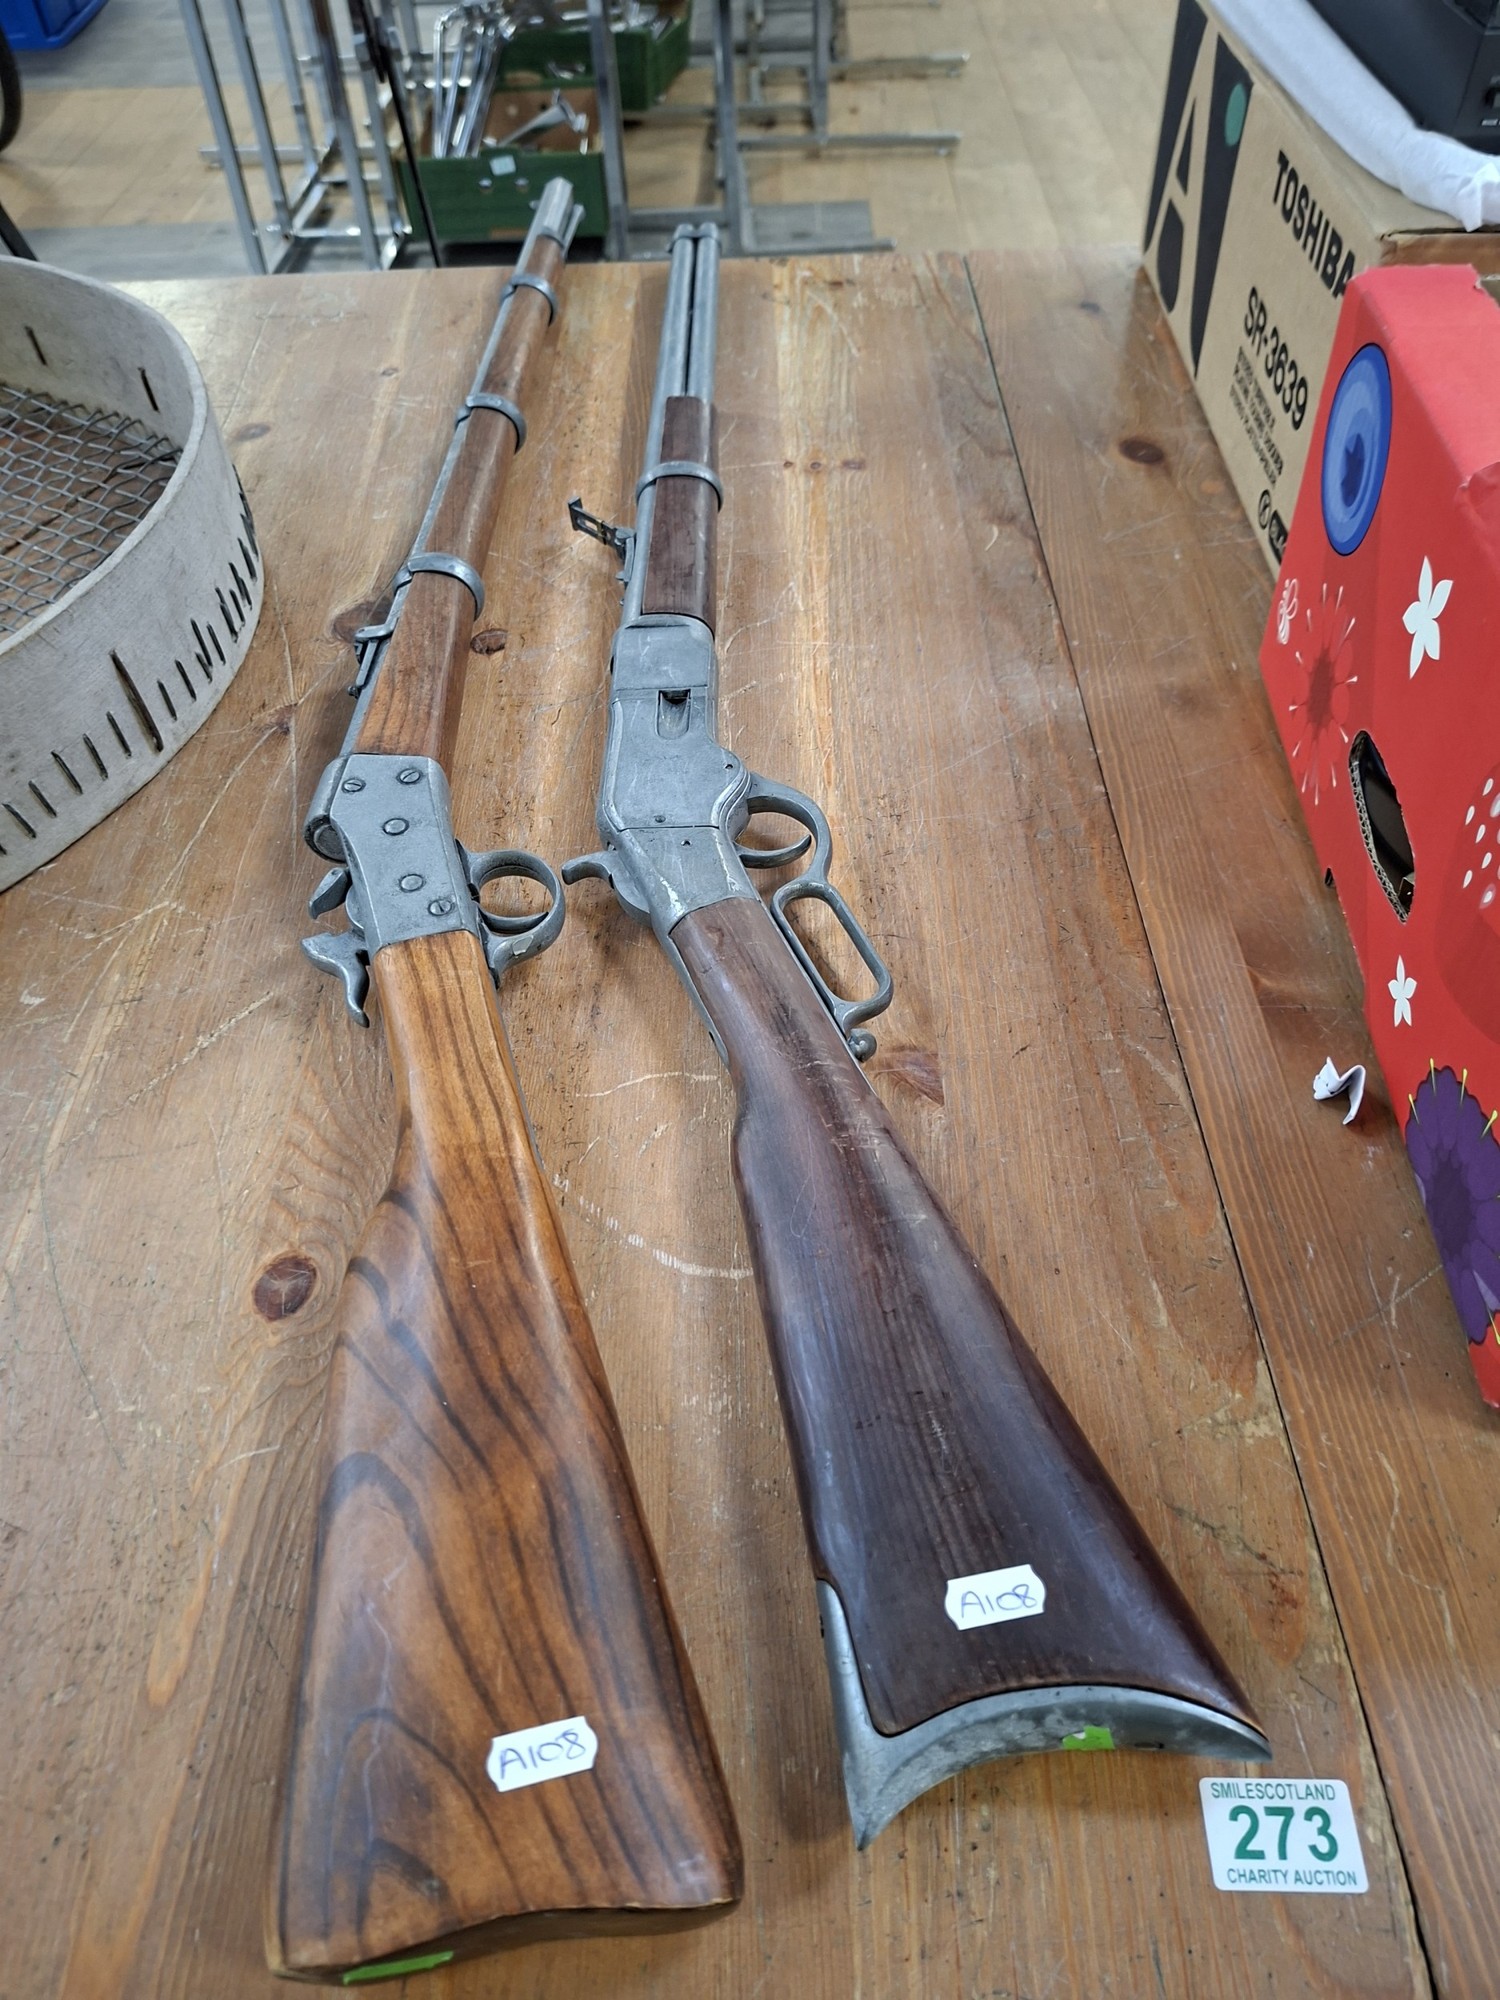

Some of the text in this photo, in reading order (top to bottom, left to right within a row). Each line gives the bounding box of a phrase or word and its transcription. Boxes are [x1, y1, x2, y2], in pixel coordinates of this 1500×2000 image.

[1273, 149, 1355, 299] TOSHIBA
[1244, 286, 1308, 431] SR-3639
[961, 1584, 1038, 1618] A108
[499, 1728, 586, 1780] A108
[1210, 1782, 1336, 1801] SMILESCOTLAND
[1228, 1804, 1339, 1863] 273
[1227, 1868, 1357, 1886] CHARITY AUCTION
